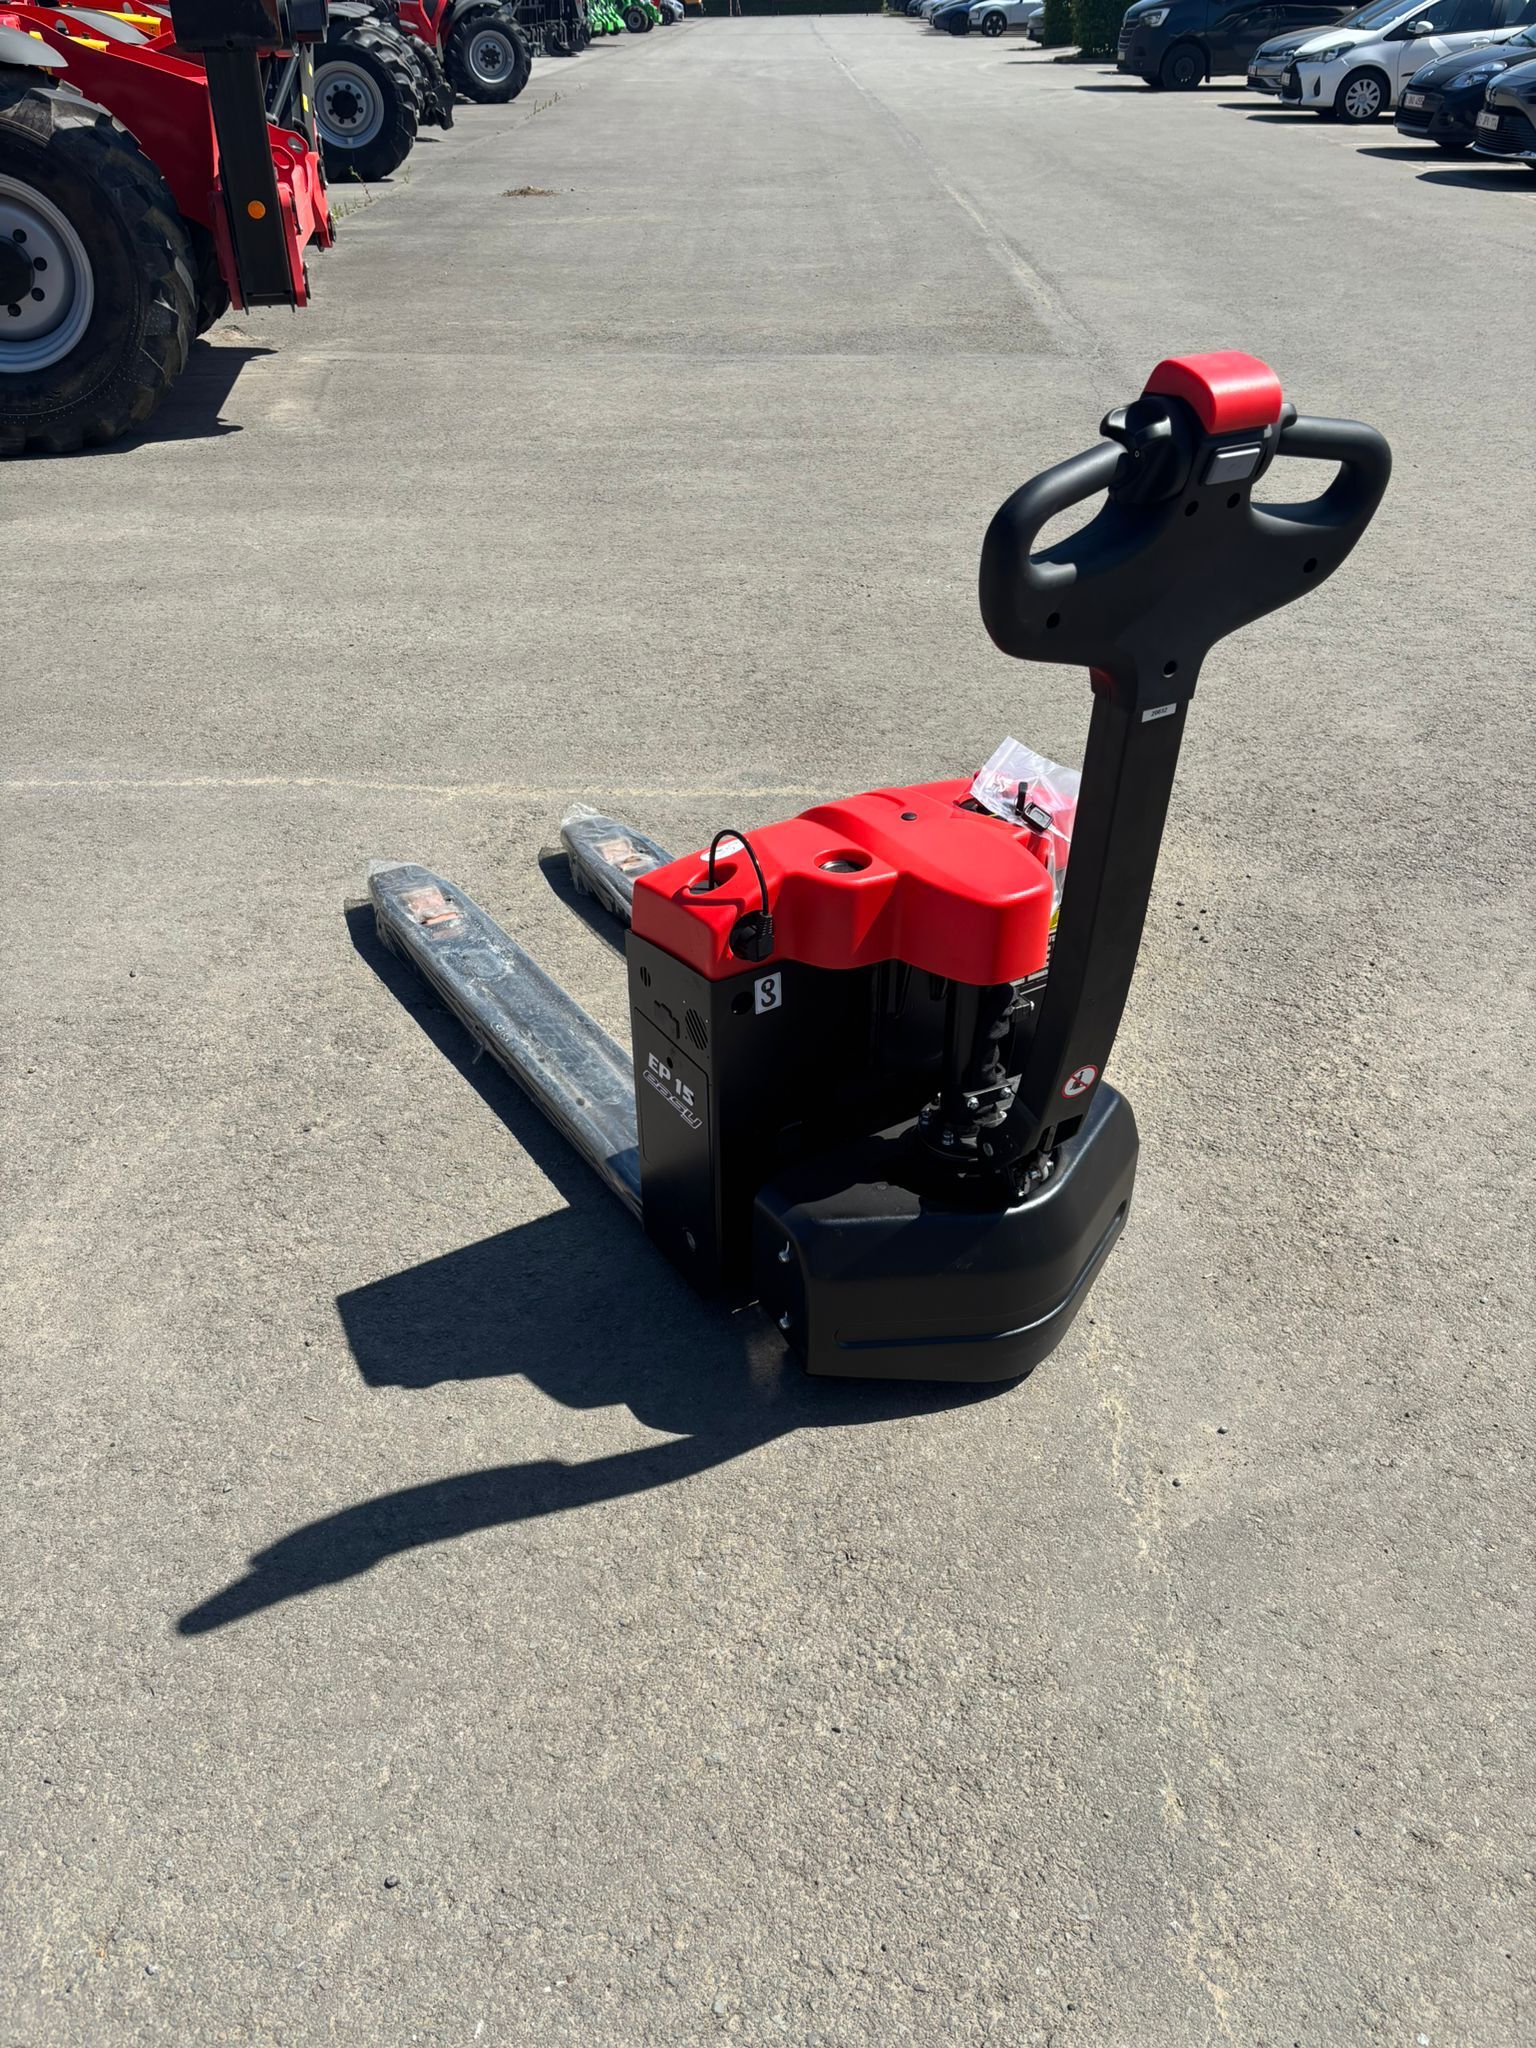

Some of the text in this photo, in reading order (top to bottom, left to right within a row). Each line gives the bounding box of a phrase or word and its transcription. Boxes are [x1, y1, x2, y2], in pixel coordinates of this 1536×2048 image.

[642, 1069, 703, 1129] easy
[648, 1052, 694, 1106] EP 15
